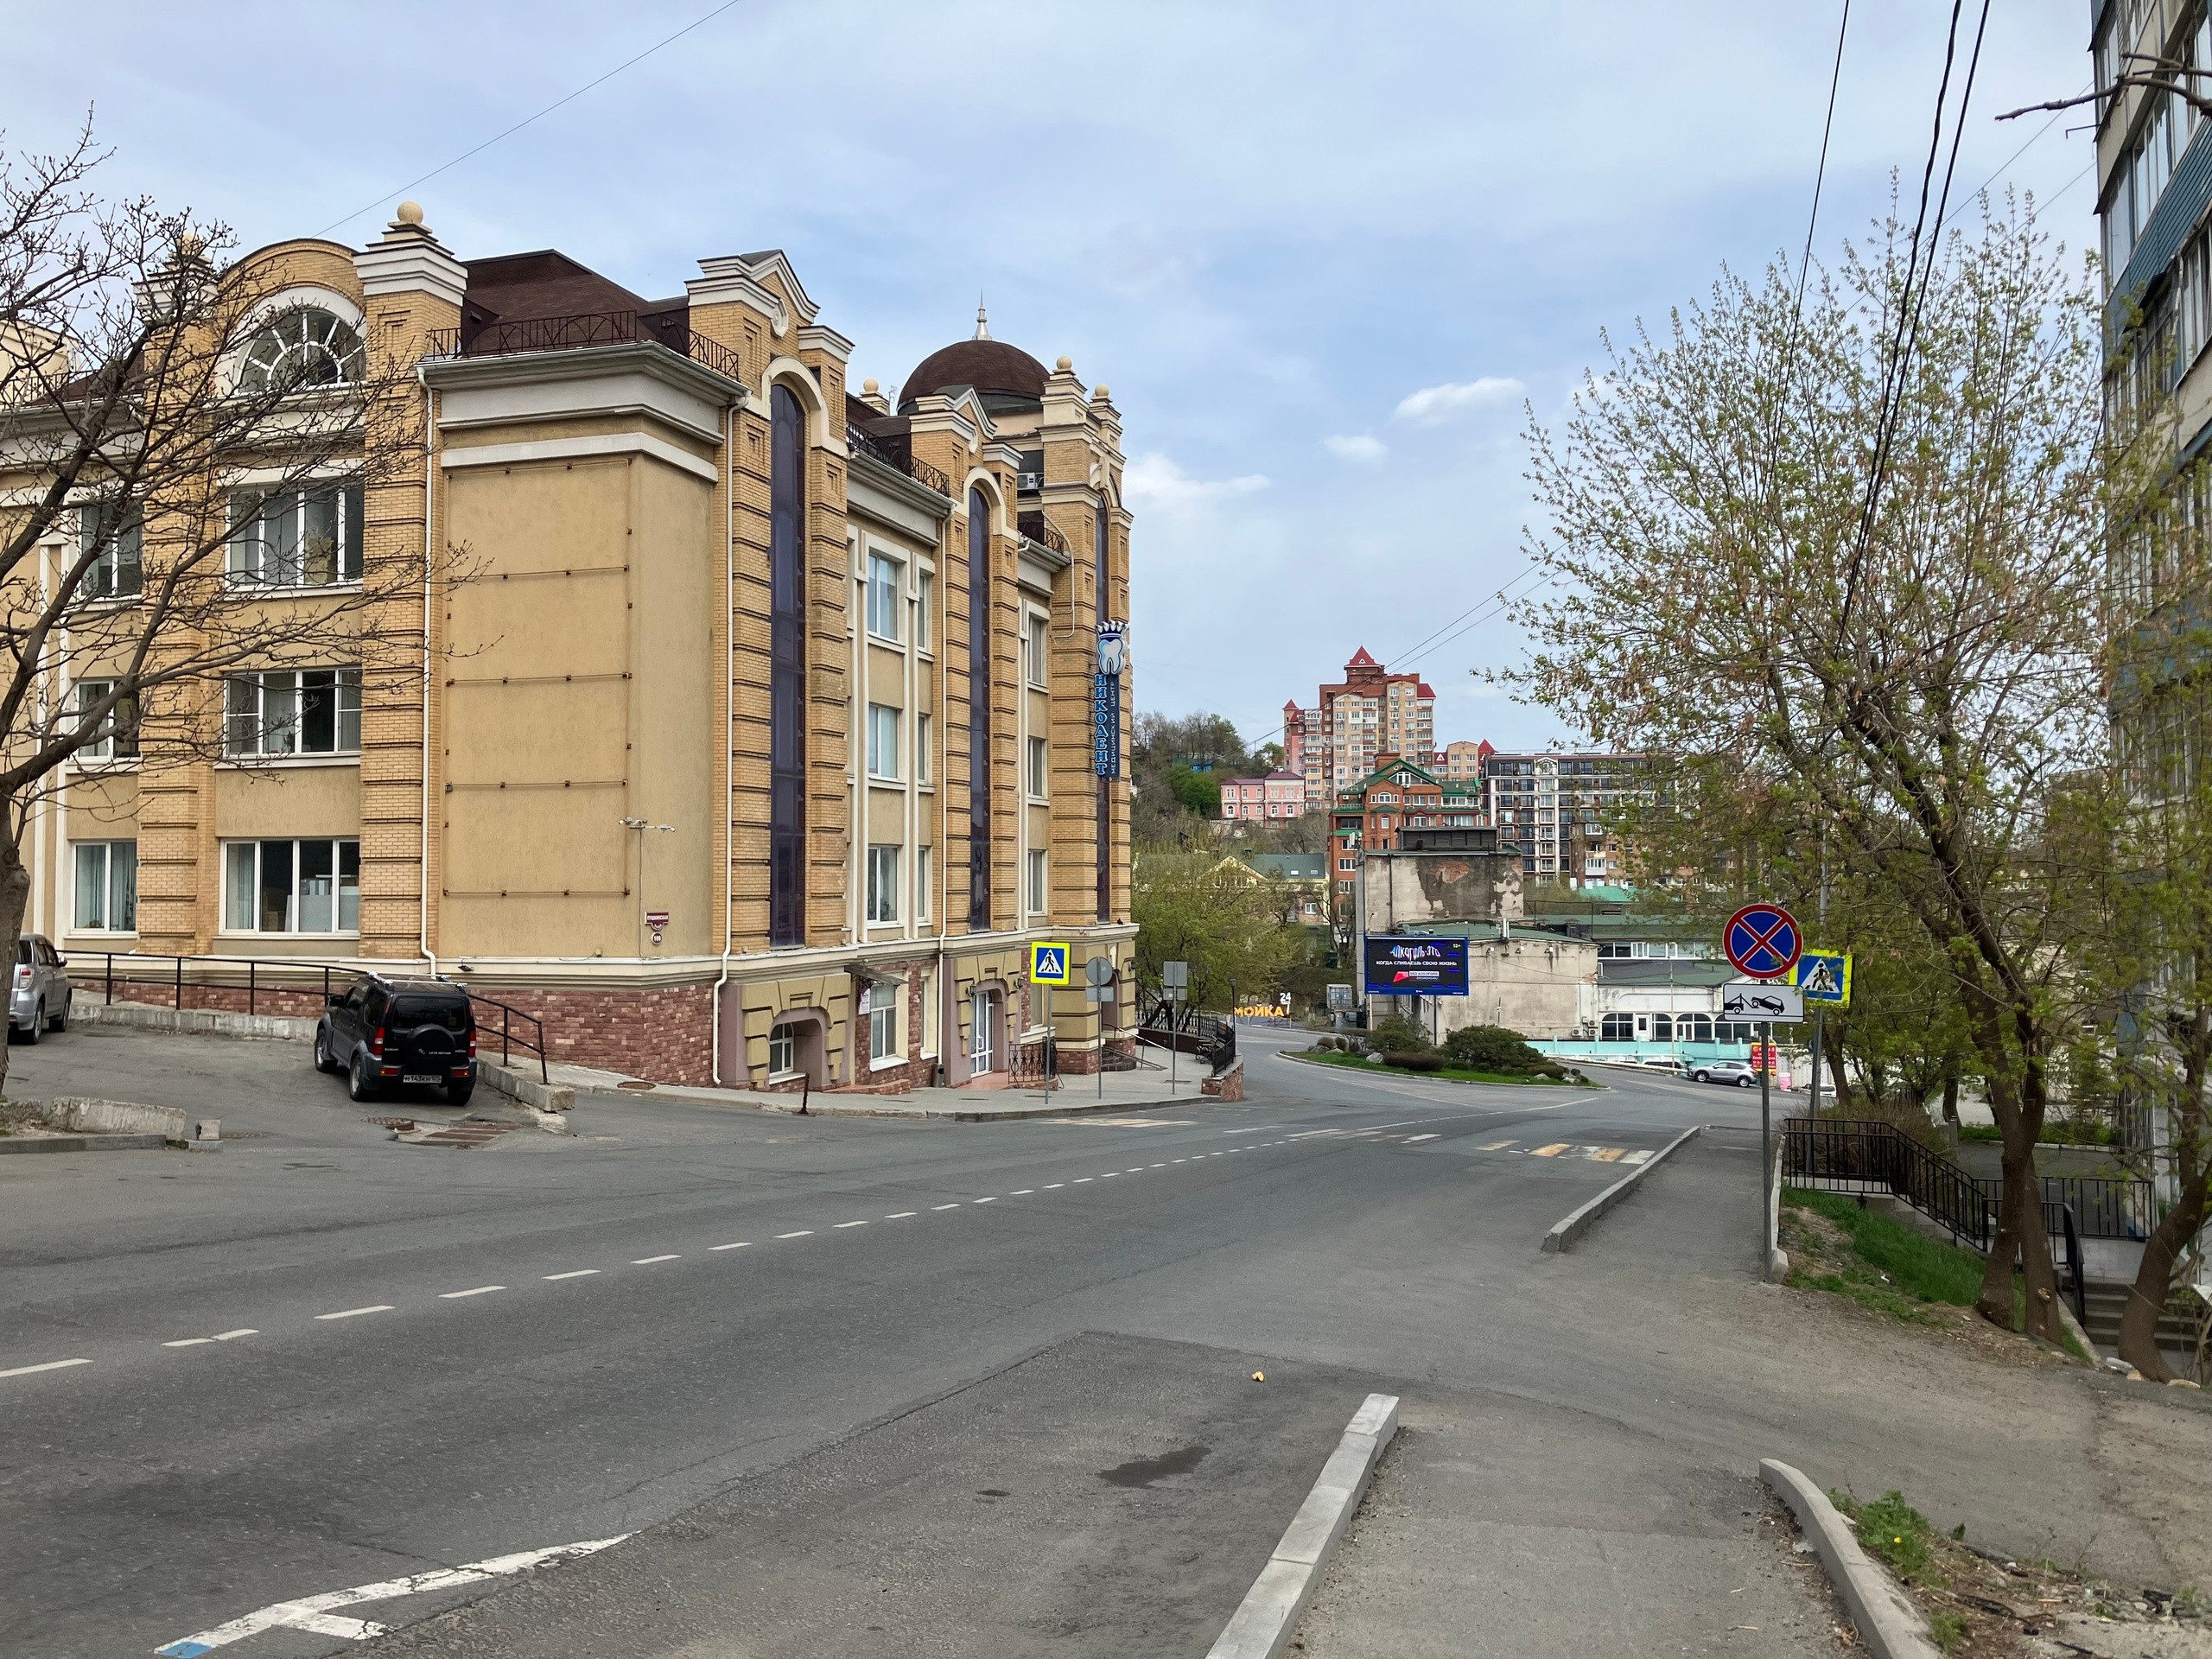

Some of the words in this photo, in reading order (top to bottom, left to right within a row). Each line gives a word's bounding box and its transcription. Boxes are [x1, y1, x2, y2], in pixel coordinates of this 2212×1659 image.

[1094, 673, 1109, 776] НИКОДЕНТ
[1280, 992, 1292, 1003] 24
[1234, 1003, 1285, 1017] МОЙКА
